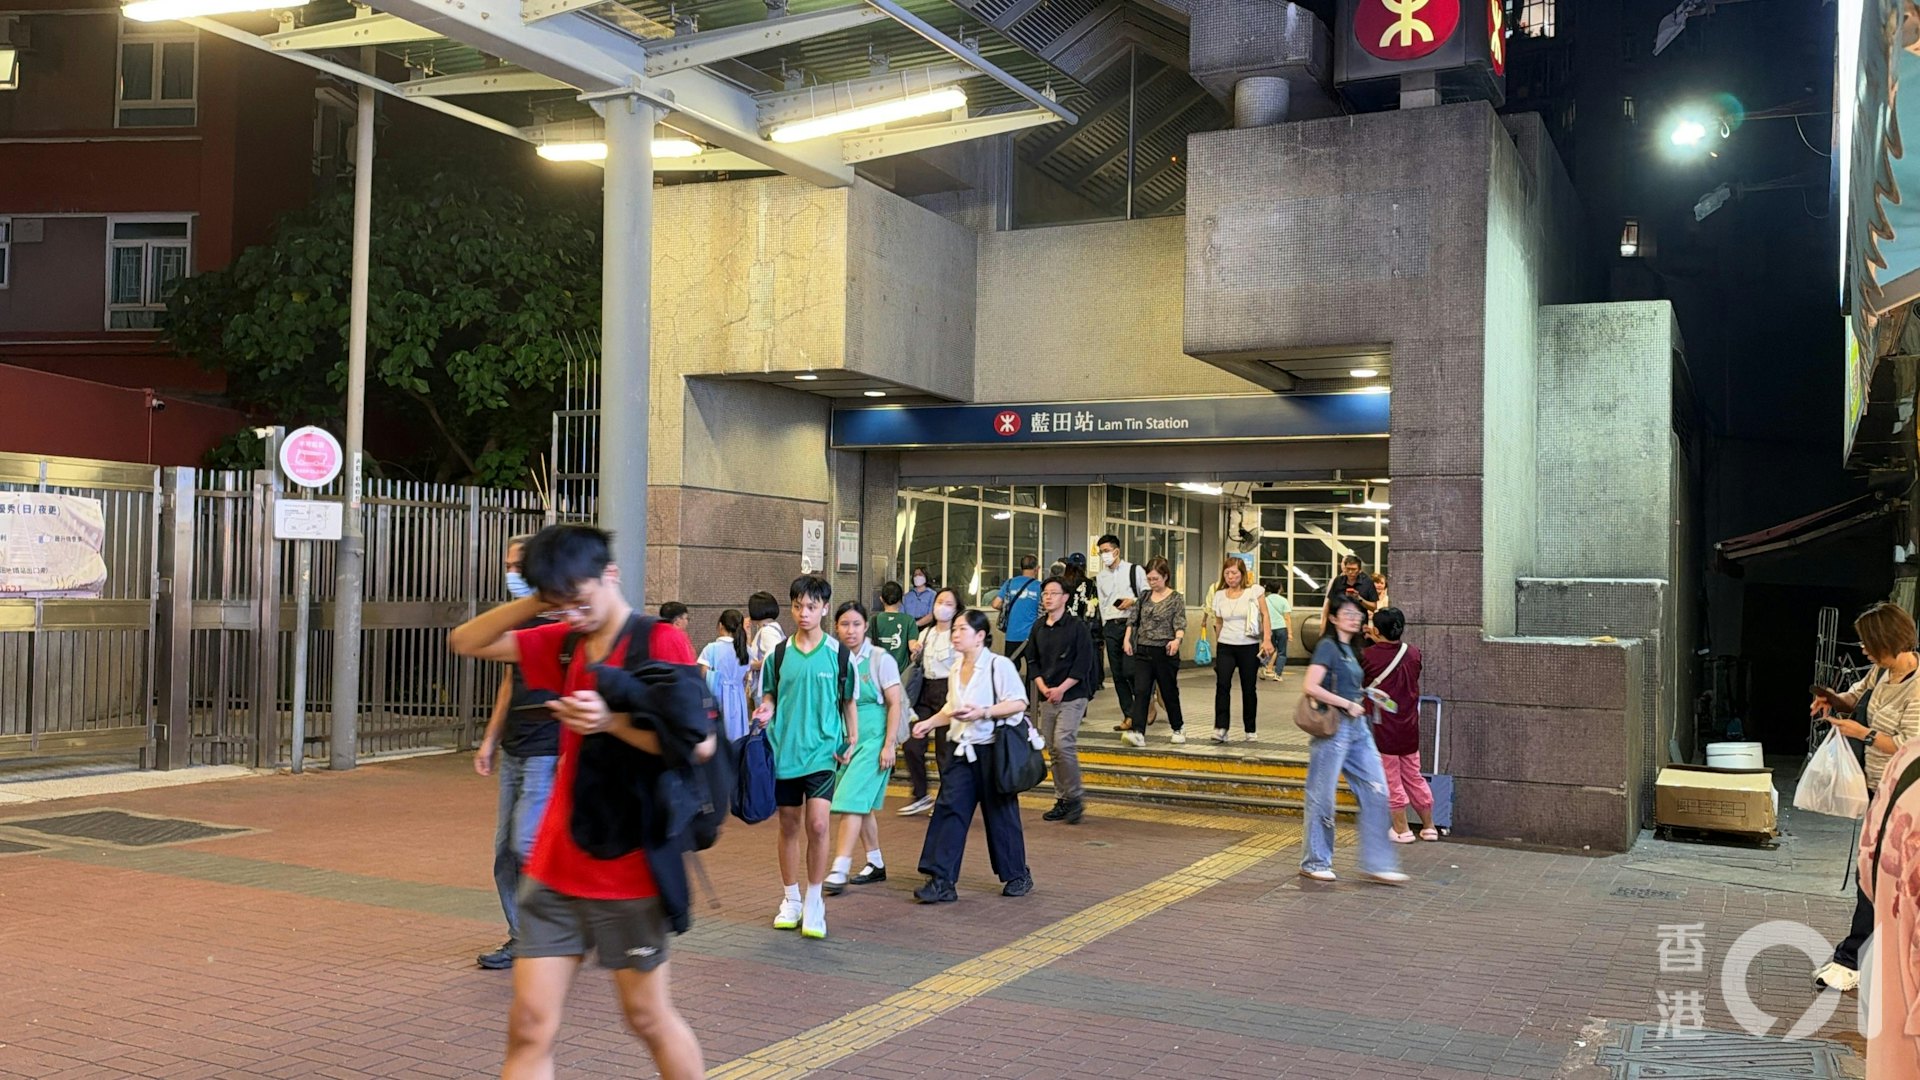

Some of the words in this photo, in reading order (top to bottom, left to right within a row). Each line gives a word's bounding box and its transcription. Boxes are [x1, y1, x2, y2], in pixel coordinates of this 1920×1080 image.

[1031, 411, 1094, 433] 藍田站
[1098, 419, 1122, 431] Lam
[1125, 417, 1143, 430] Tin
[1146, 416, 1189, 430] Station
